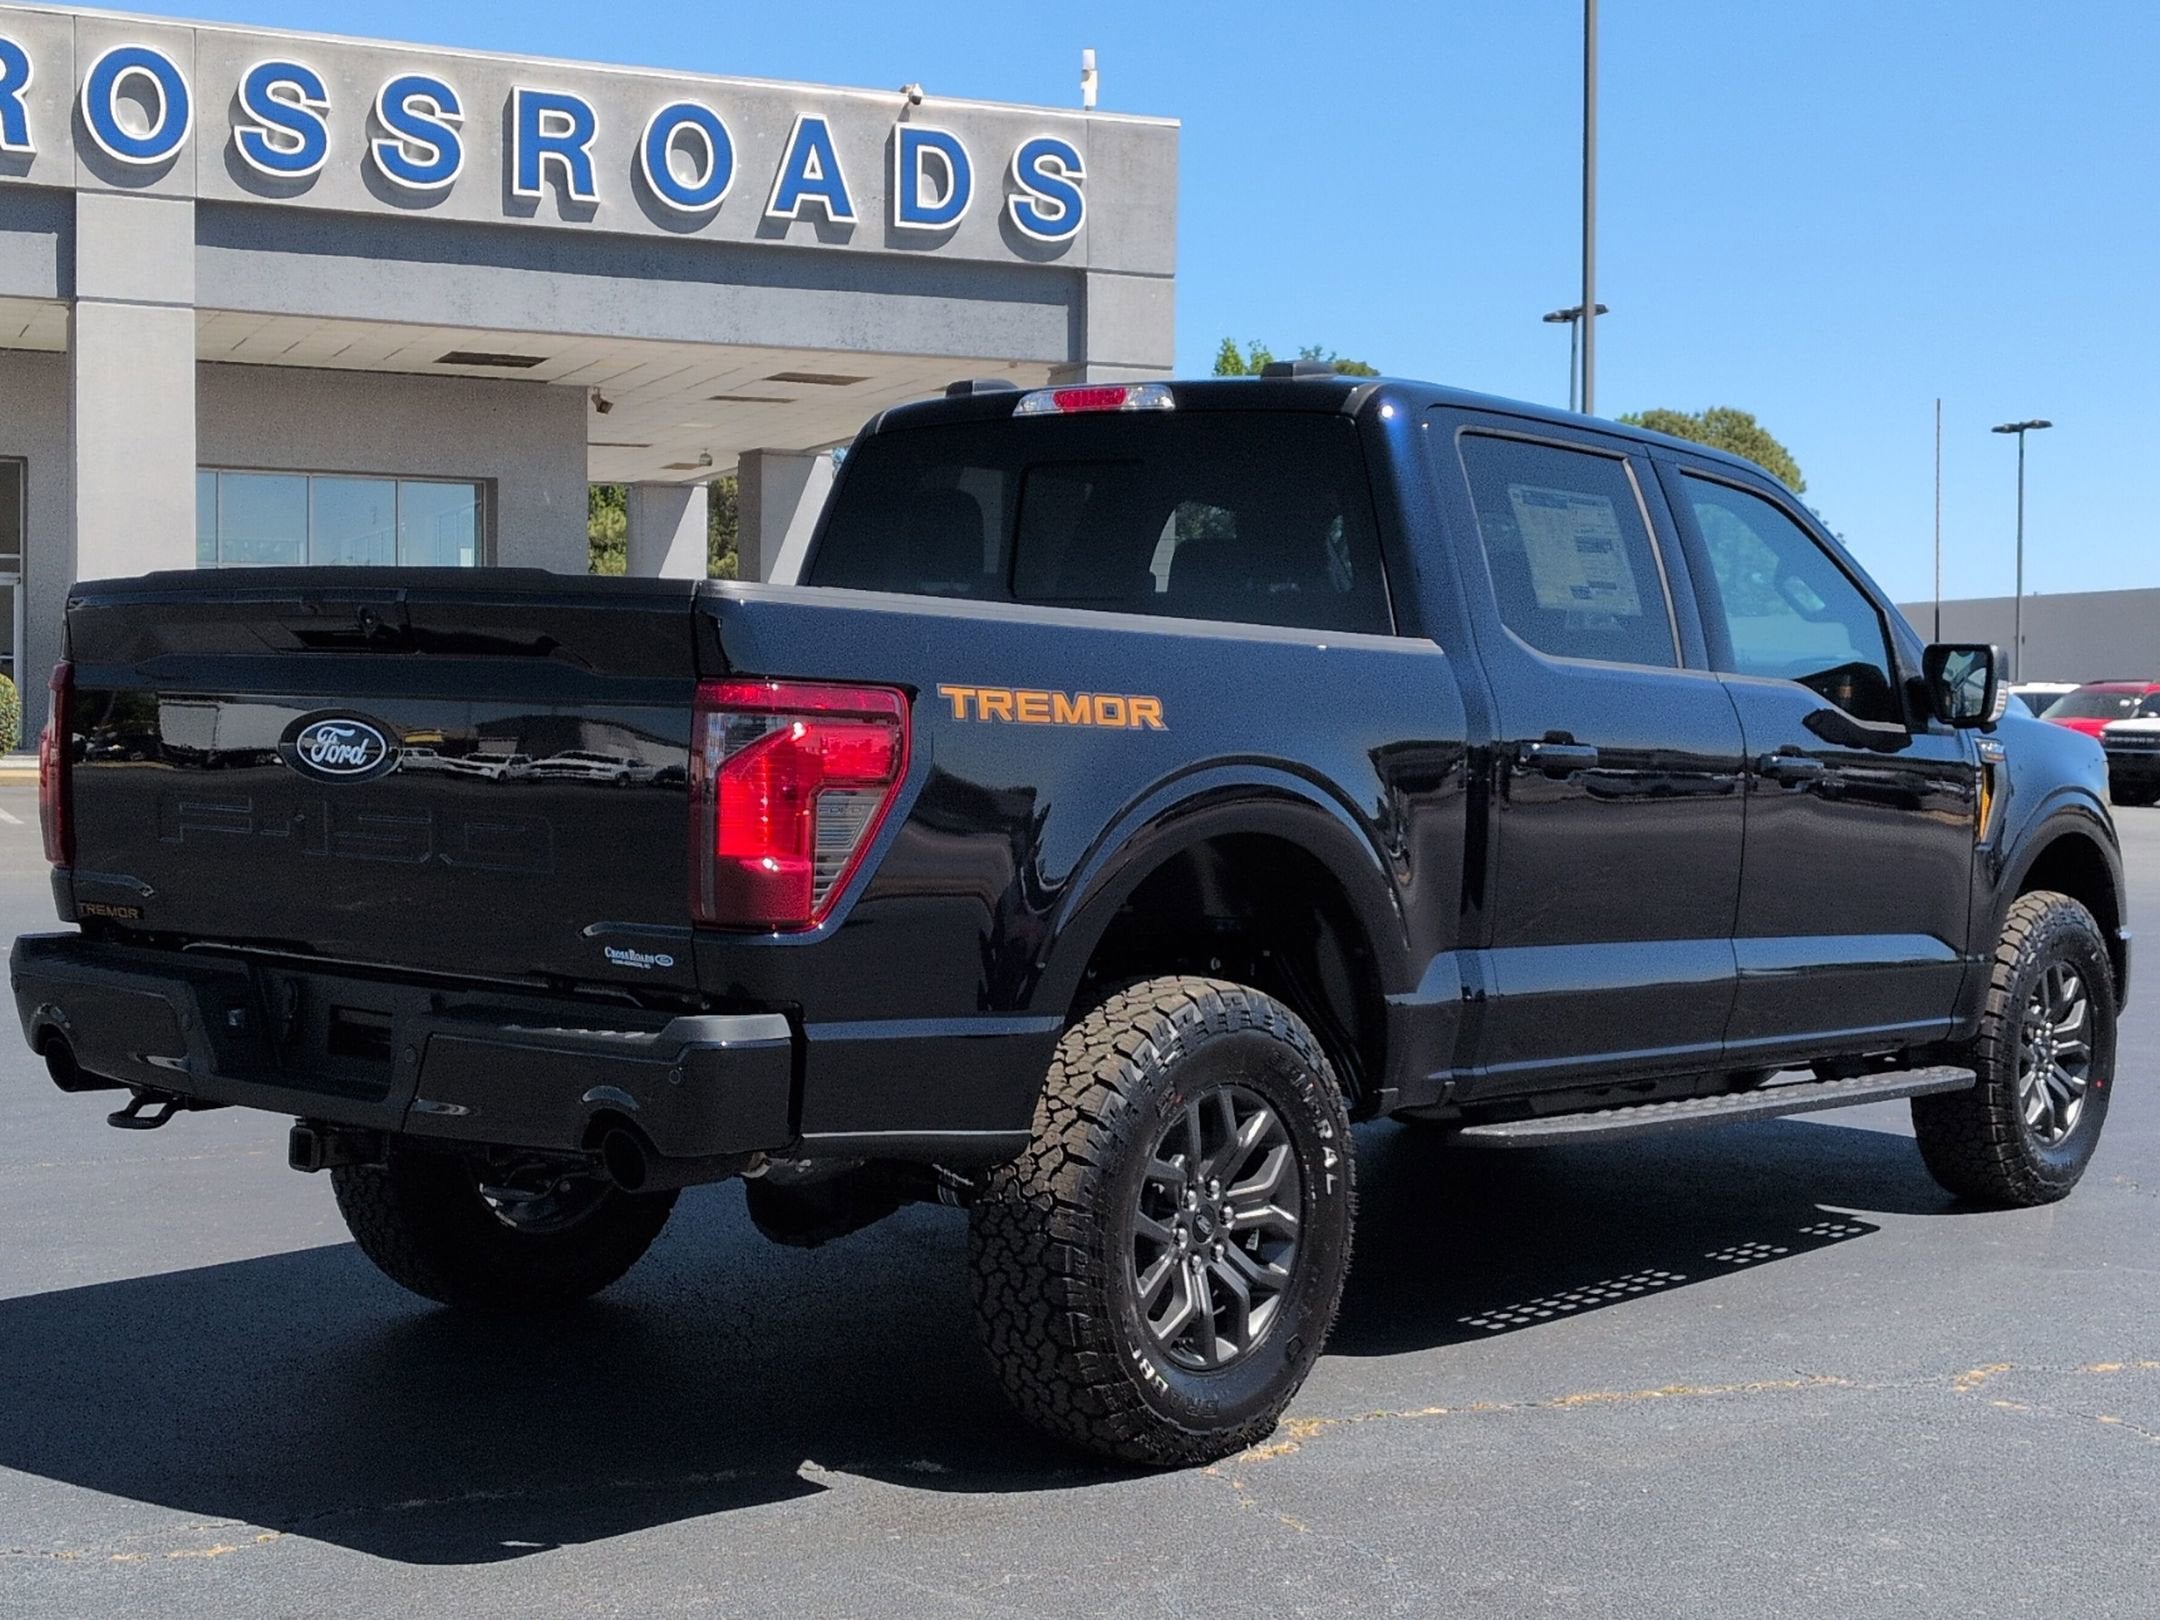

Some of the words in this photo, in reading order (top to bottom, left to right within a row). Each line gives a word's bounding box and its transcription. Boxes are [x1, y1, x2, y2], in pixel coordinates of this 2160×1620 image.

[936, 682, 1170, 732] TREMOR
[310, 726, 369, 766] Ford
[78, 902, 140, 919] TREMOR
